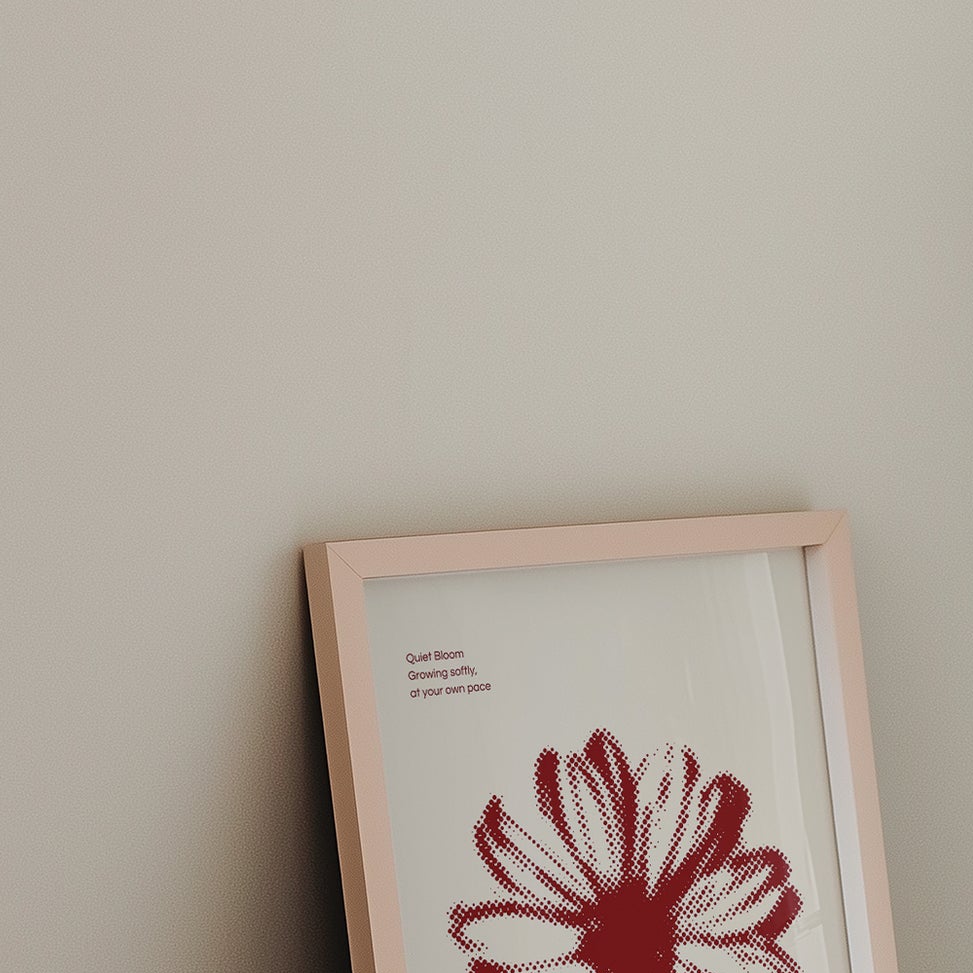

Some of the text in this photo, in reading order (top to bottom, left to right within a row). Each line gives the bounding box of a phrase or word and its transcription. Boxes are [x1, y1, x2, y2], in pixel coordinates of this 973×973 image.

[405, 650, 465, 665] Quiet Bloom
[408, 665, 478, 680] Growing softly,
[410, 682, 492, 699] at your own pace
